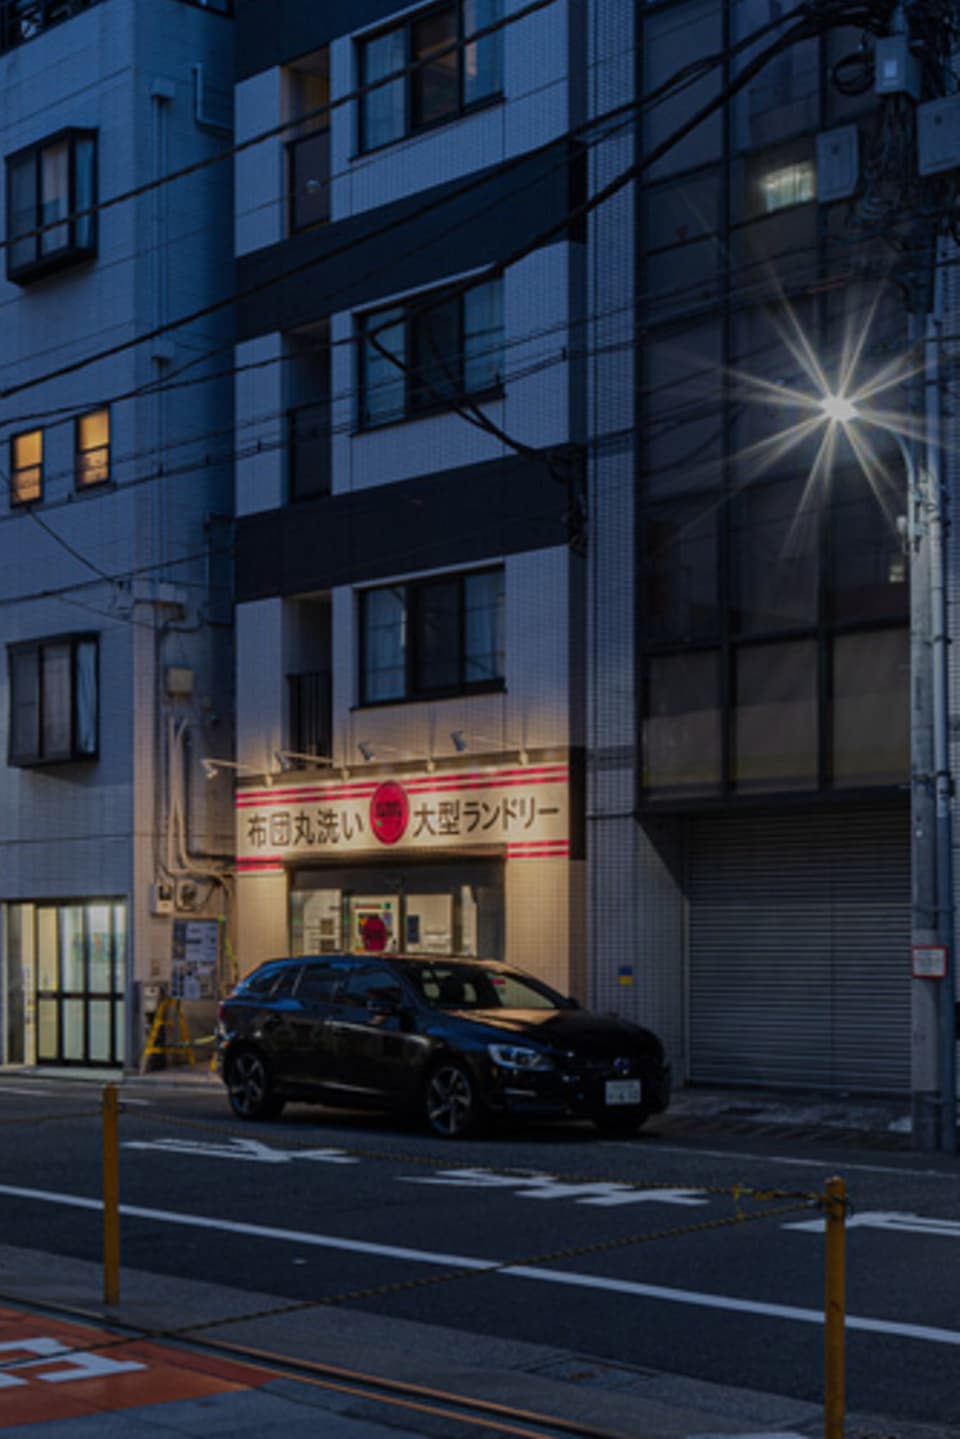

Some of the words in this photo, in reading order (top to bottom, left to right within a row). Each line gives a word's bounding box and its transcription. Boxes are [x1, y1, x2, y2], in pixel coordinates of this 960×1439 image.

[247, 808, 363, 847] 布団丸洗い
[413, 797, 559, 837] 大型ランドリー
